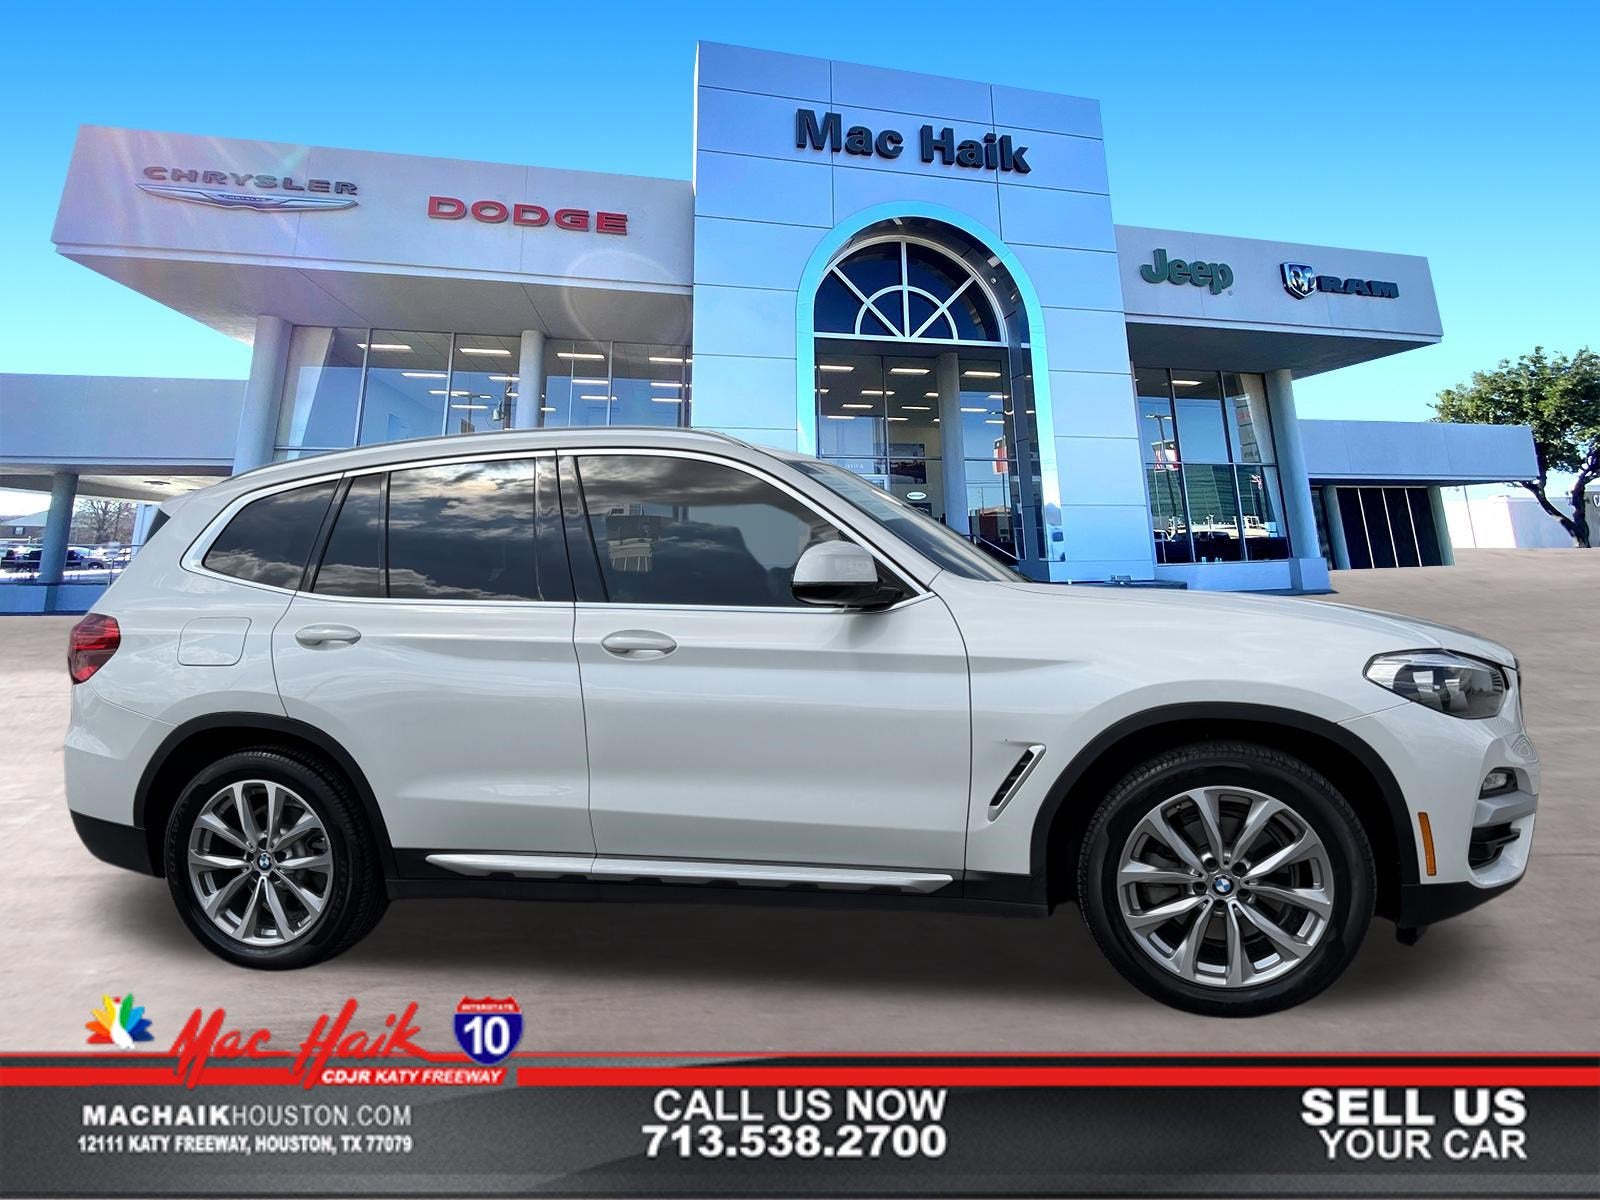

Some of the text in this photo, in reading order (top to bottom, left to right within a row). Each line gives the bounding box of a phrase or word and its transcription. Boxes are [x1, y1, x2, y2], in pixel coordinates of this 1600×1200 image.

[796, 108, 1032, 174] Mac Haik
[143, 166, 358, 196] CHRYSLER
[428, 195, 628, 236] DODGE
[1139, 248, 1234, 295] Jeep
[1315, 275, 1400, 299] RAM
